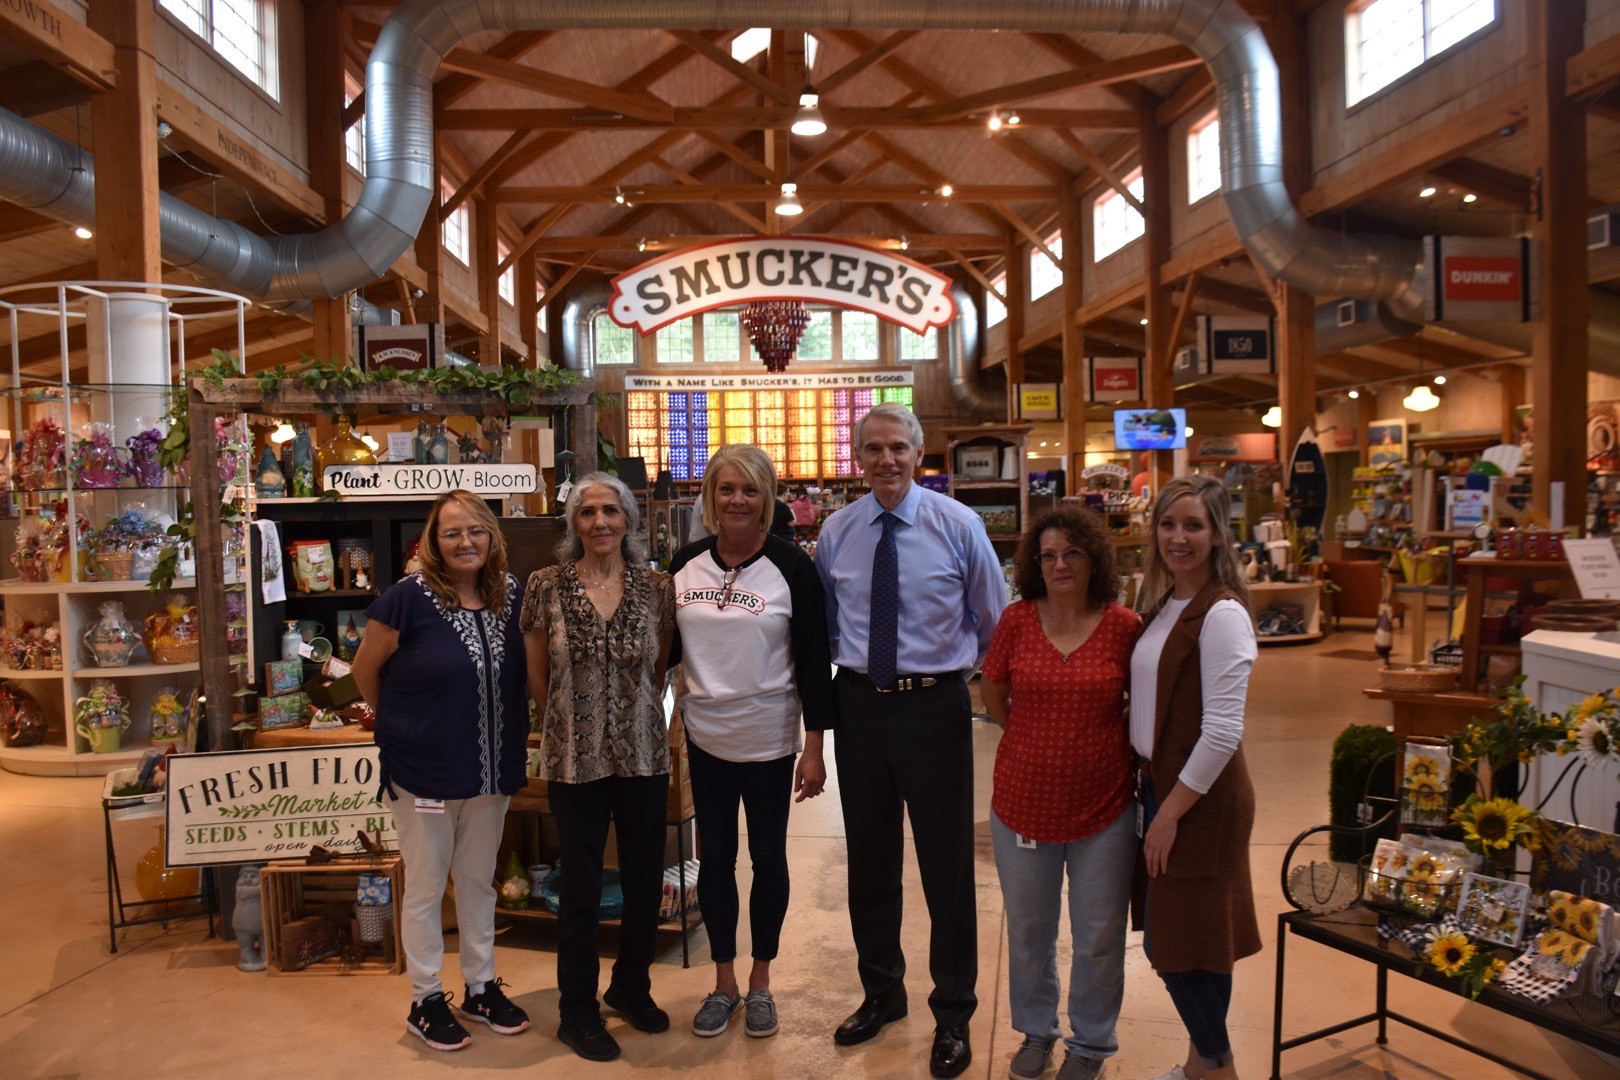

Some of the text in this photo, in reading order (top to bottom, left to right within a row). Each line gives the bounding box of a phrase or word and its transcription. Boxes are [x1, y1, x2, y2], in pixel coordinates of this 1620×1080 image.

[217, 128, 279, 185] INDEPENDENCE
[636, 248, 932, 316] SMUCKER'S
[966, 460, 990, 468] EGGS
[330, 469, 531, 490] Plant GROW Bloom
[683, 591, 759, 608] SMUCER'S
[177, 757, 374, 814] FRESH FLO
[266, 790, 366, 818] Market
[185, 825, 248, 845] SEEDS
[273, 819, 341, 839] STEMS
[264, 841, 308, 852] open
